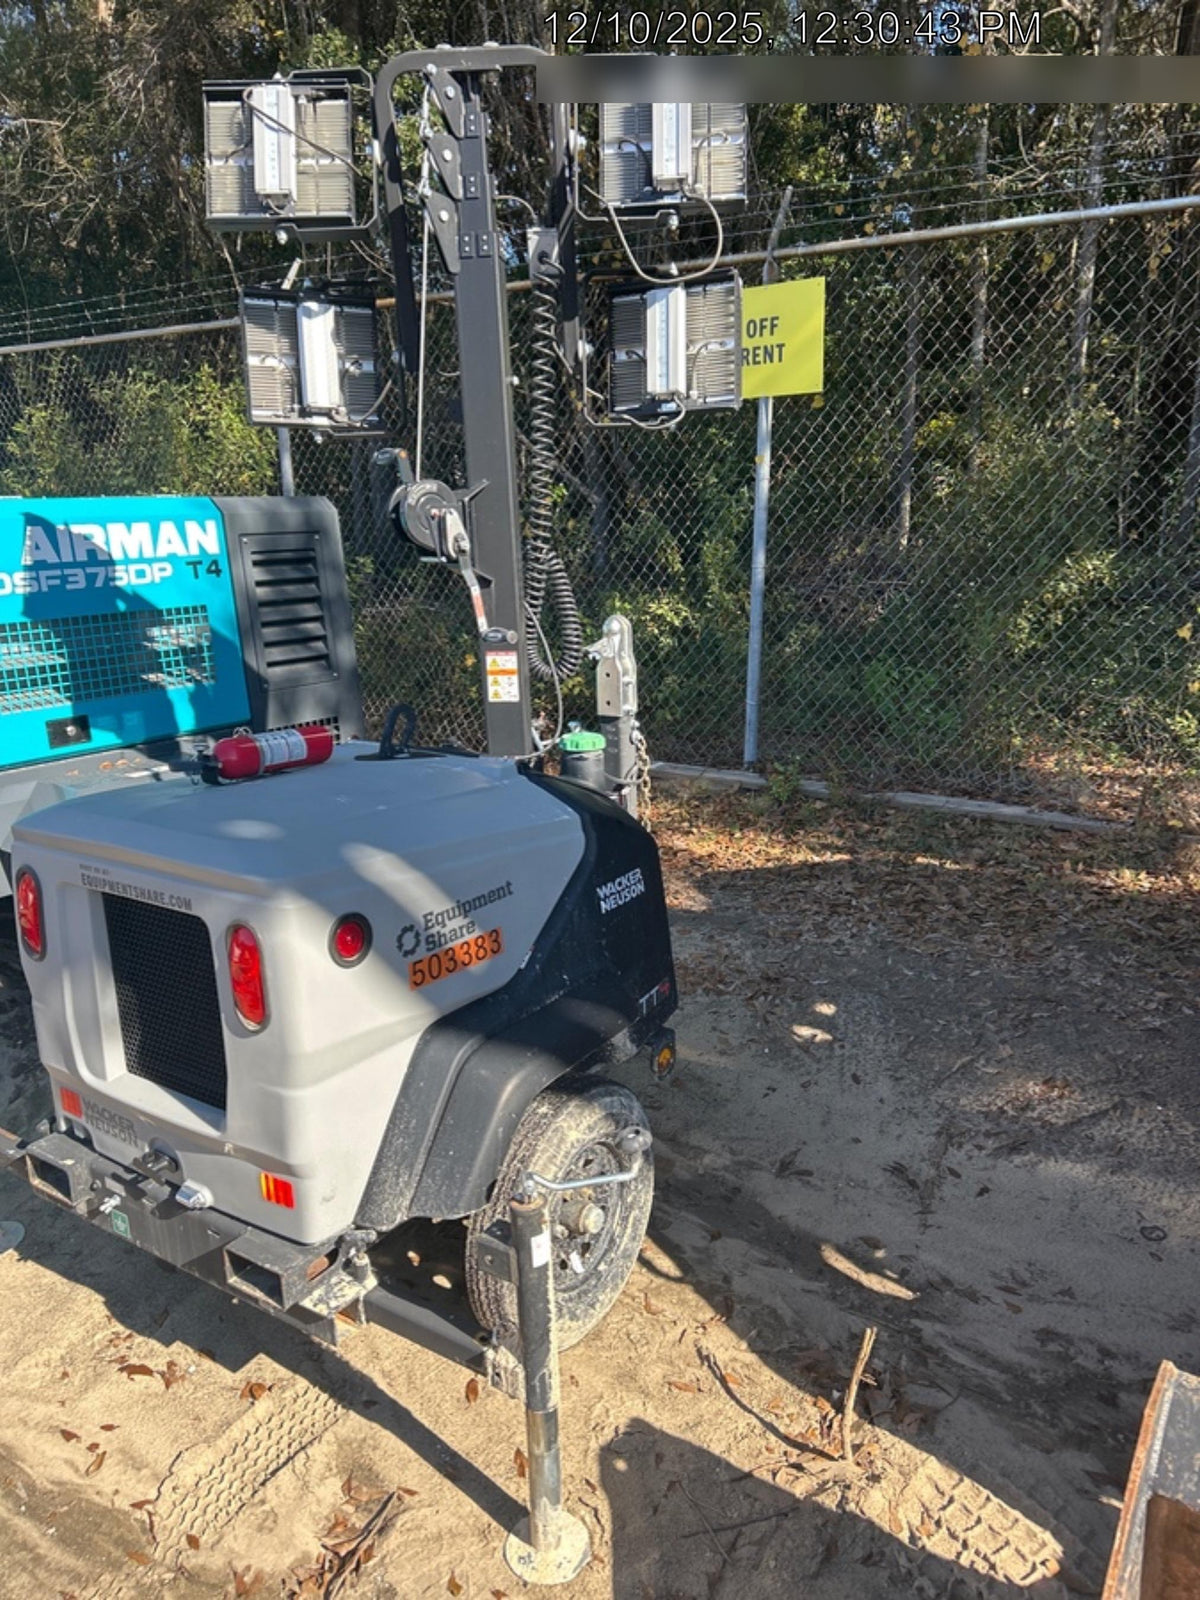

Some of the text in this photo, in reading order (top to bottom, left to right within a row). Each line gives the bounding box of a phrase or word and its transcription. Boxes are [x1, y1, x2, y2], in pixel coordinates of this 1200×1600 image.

[746, 316, 780, 338] OFF
[741, 342, 786, 367] RENT
[21, 519, 220, 566] AIRMAN
[186, 559, 222, 579] T4
[80, 872, 192, 911] EQUIPMENTSHARE.COM
[596, 867, 643, 898] WACKER
[600, 880, 646, 914] NEUSON
[422, 880, 514, 931] Equipment
[425, 920, 476, 952] Share
[412, 929, 502, 987] 503383
[82, 1097, 134, 1129] WACKER
[85, 1114, 139, 1148] NEUSON
